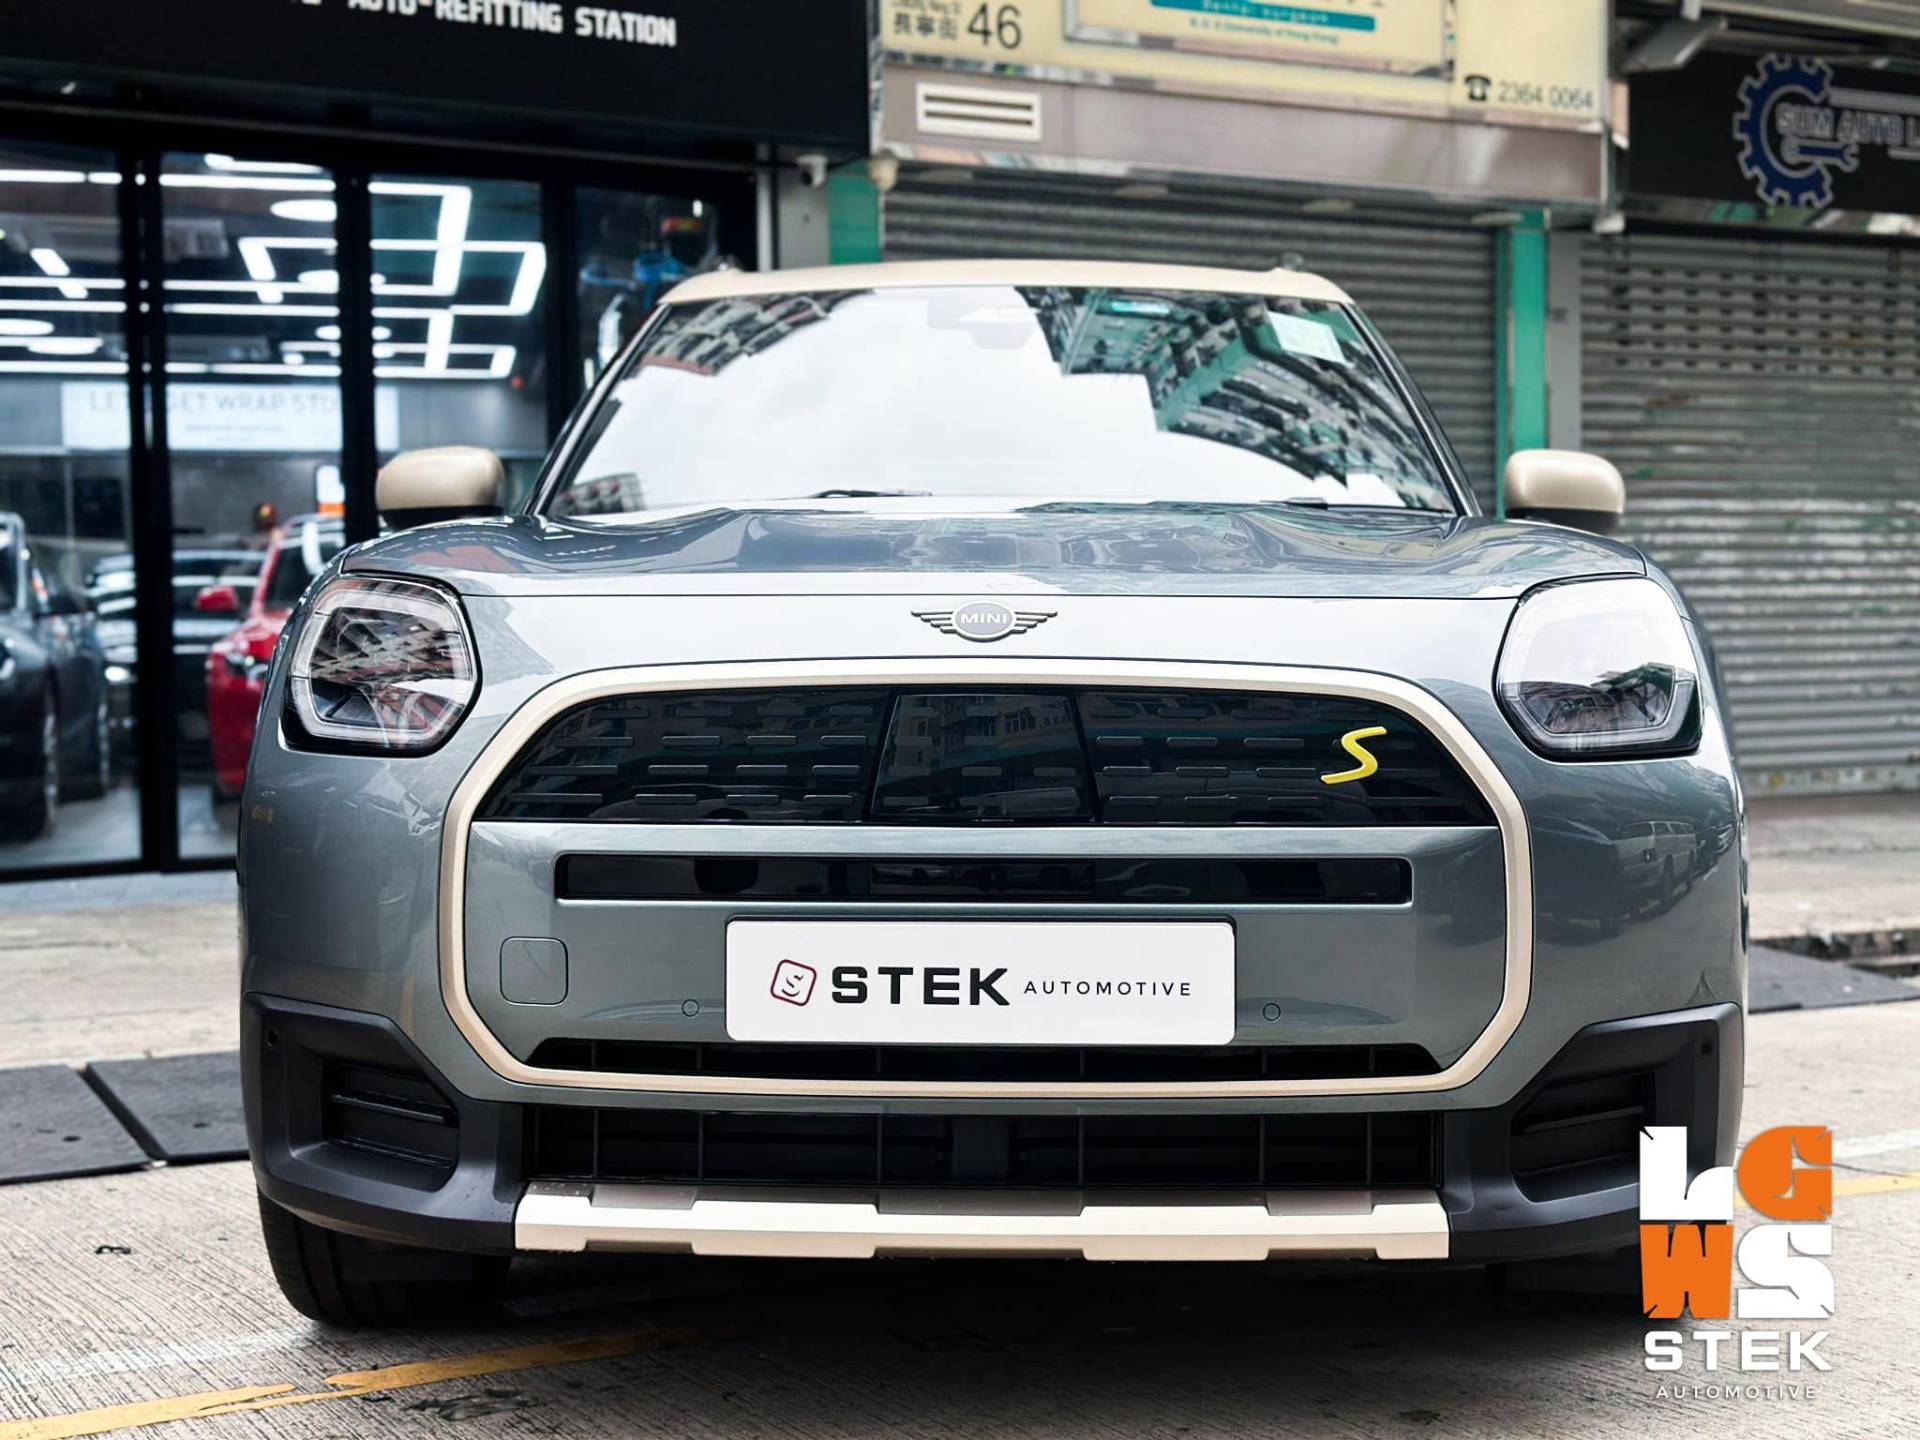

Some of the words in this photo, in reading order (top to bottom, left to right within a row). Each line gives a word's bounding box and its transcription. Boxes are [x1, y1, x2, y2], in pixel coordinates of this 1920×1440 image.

[574, 6, 677, 47] STATION
[967, 3, 1022, 49] 46
[212, 391, 286, 412] WRAP
[960, 613, 1008, 624] MINI
[1321, 726, 1387, 785] S
[832, 966, 1010, 1006] STEK
[1024, 980, 1191, 996] AUTOMOTIVE
